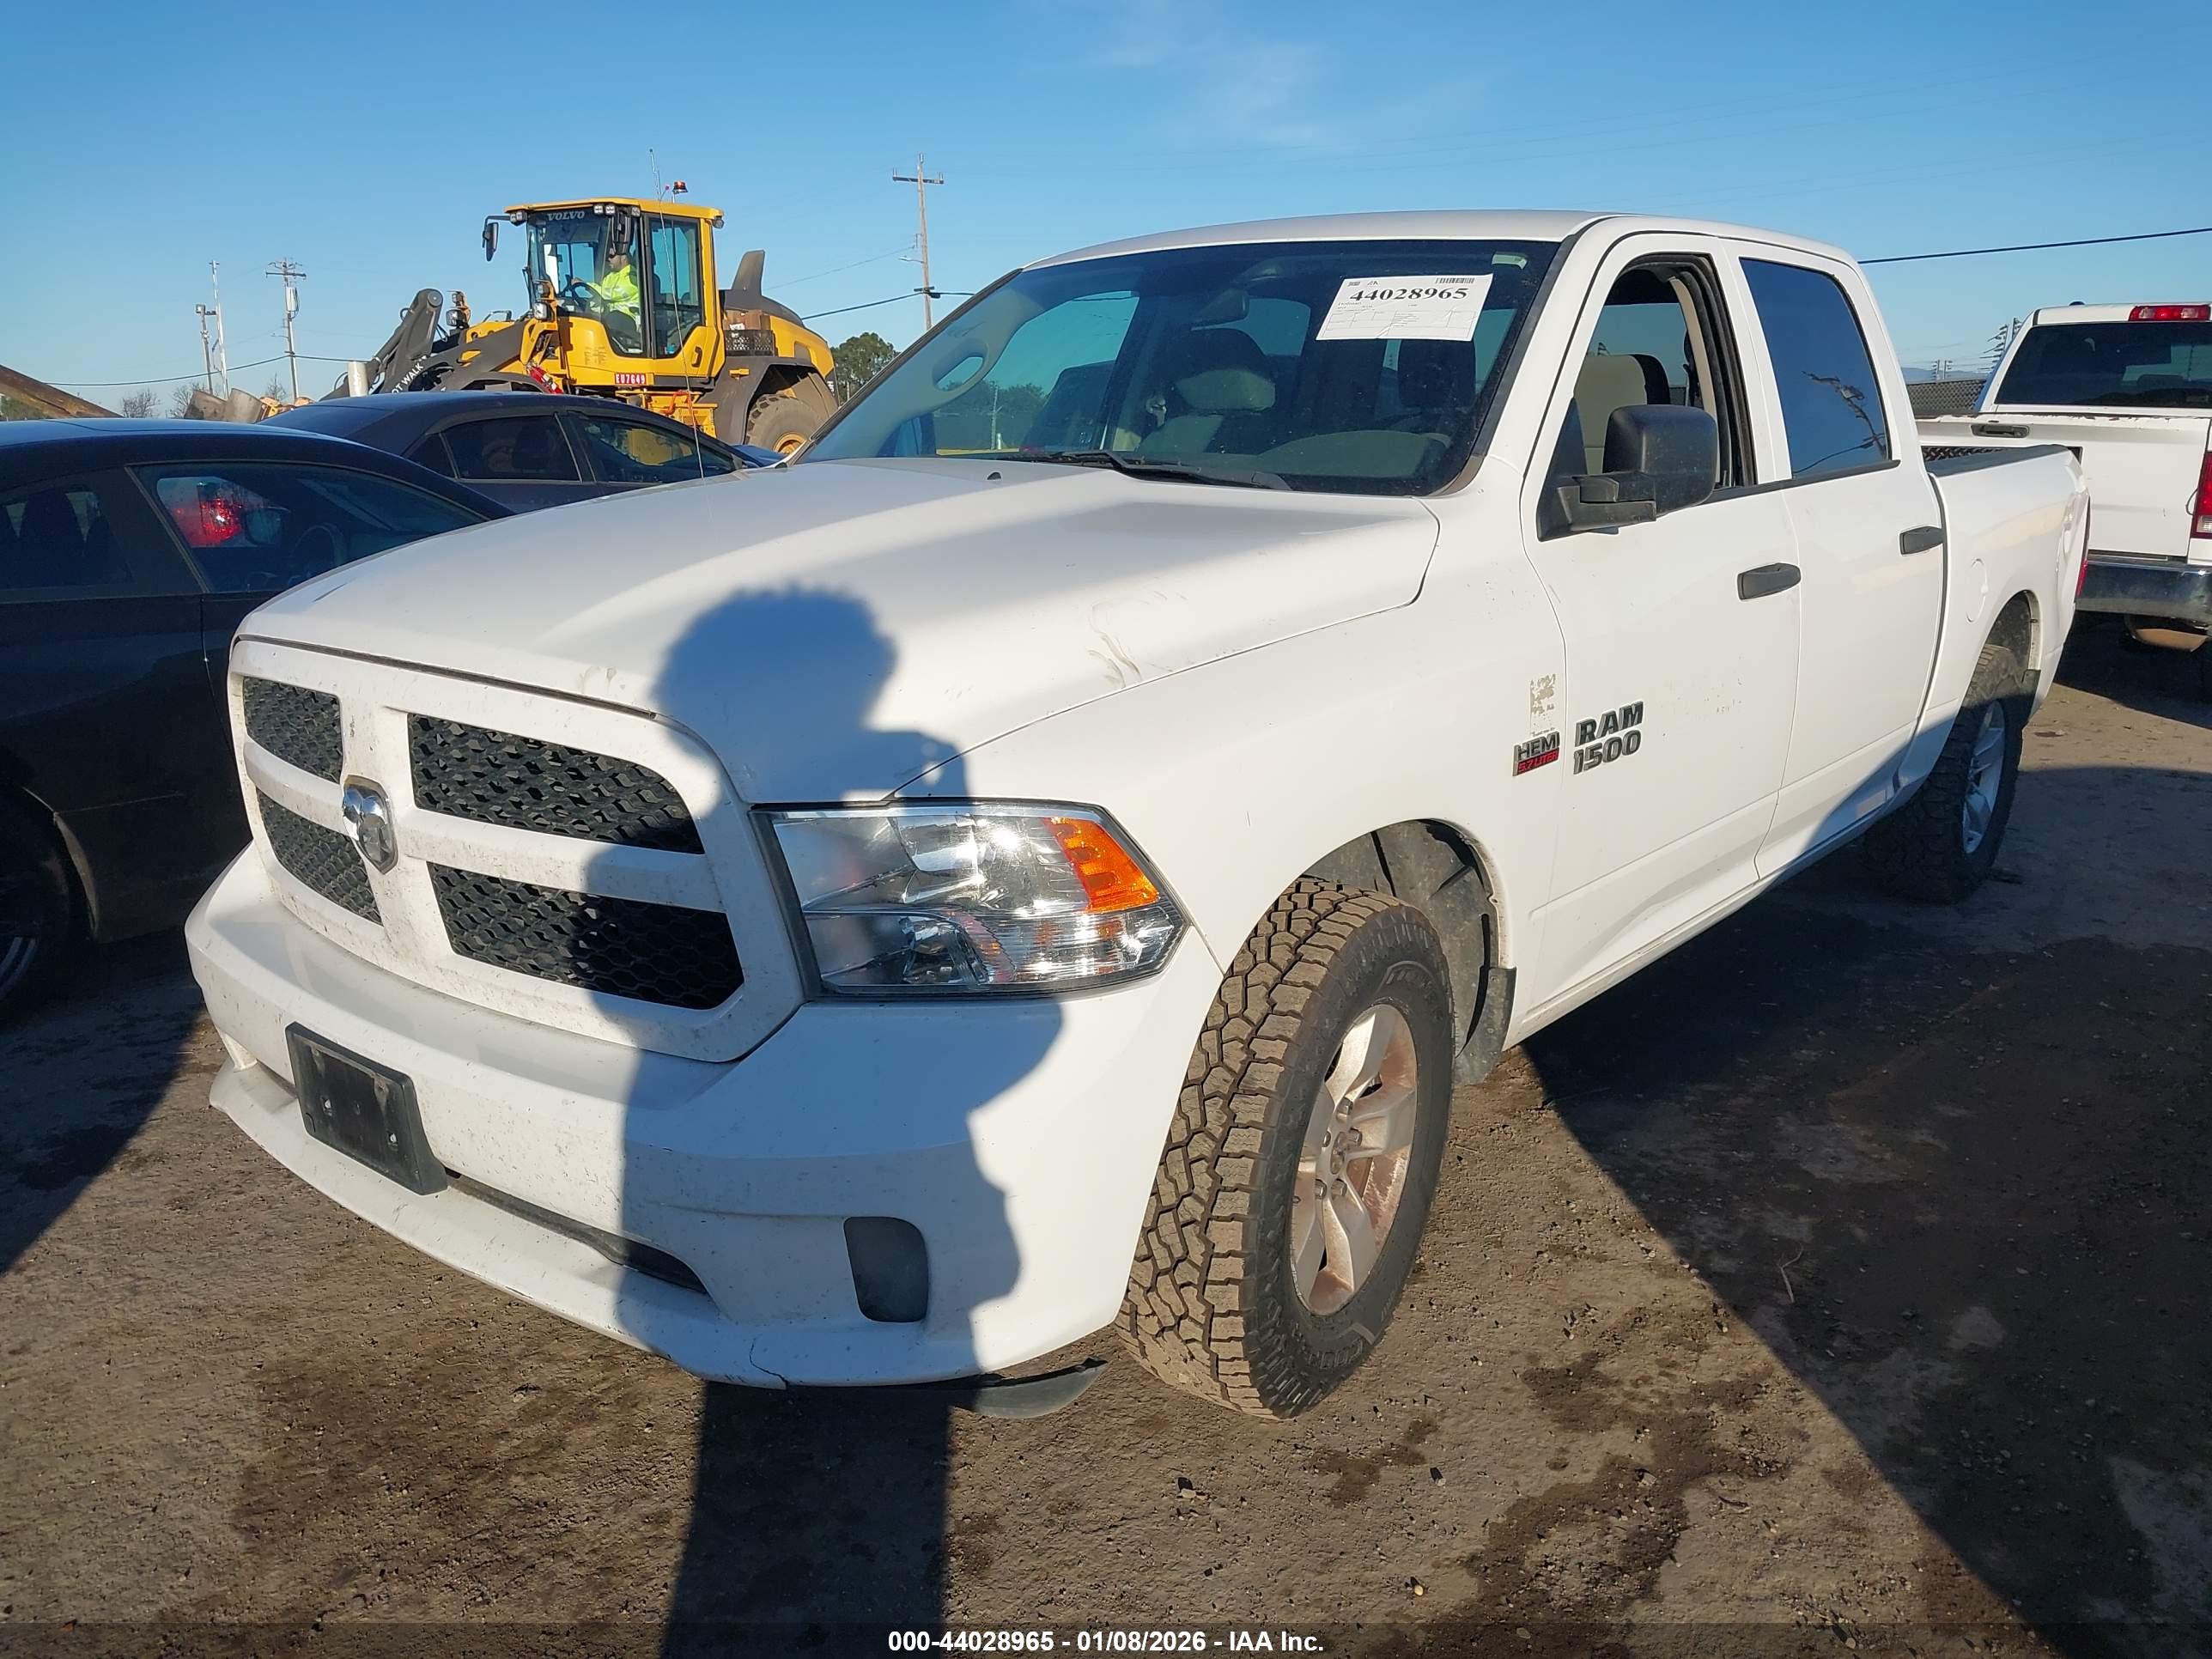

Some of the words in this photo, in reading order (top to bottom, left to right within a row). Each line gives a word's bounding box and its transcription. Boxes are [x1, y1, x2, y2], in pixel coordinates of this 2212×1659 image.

[547, 210, 585, 221] VOLVO
[1349, 288, 1469, 301] 44028965
[401, 362, 424, 385] WALK
[1575, 701, 1644, 747] RAM
[1514, 731, 1560, 762] HEMI
[1573, 730, 1642, 775] 1500
